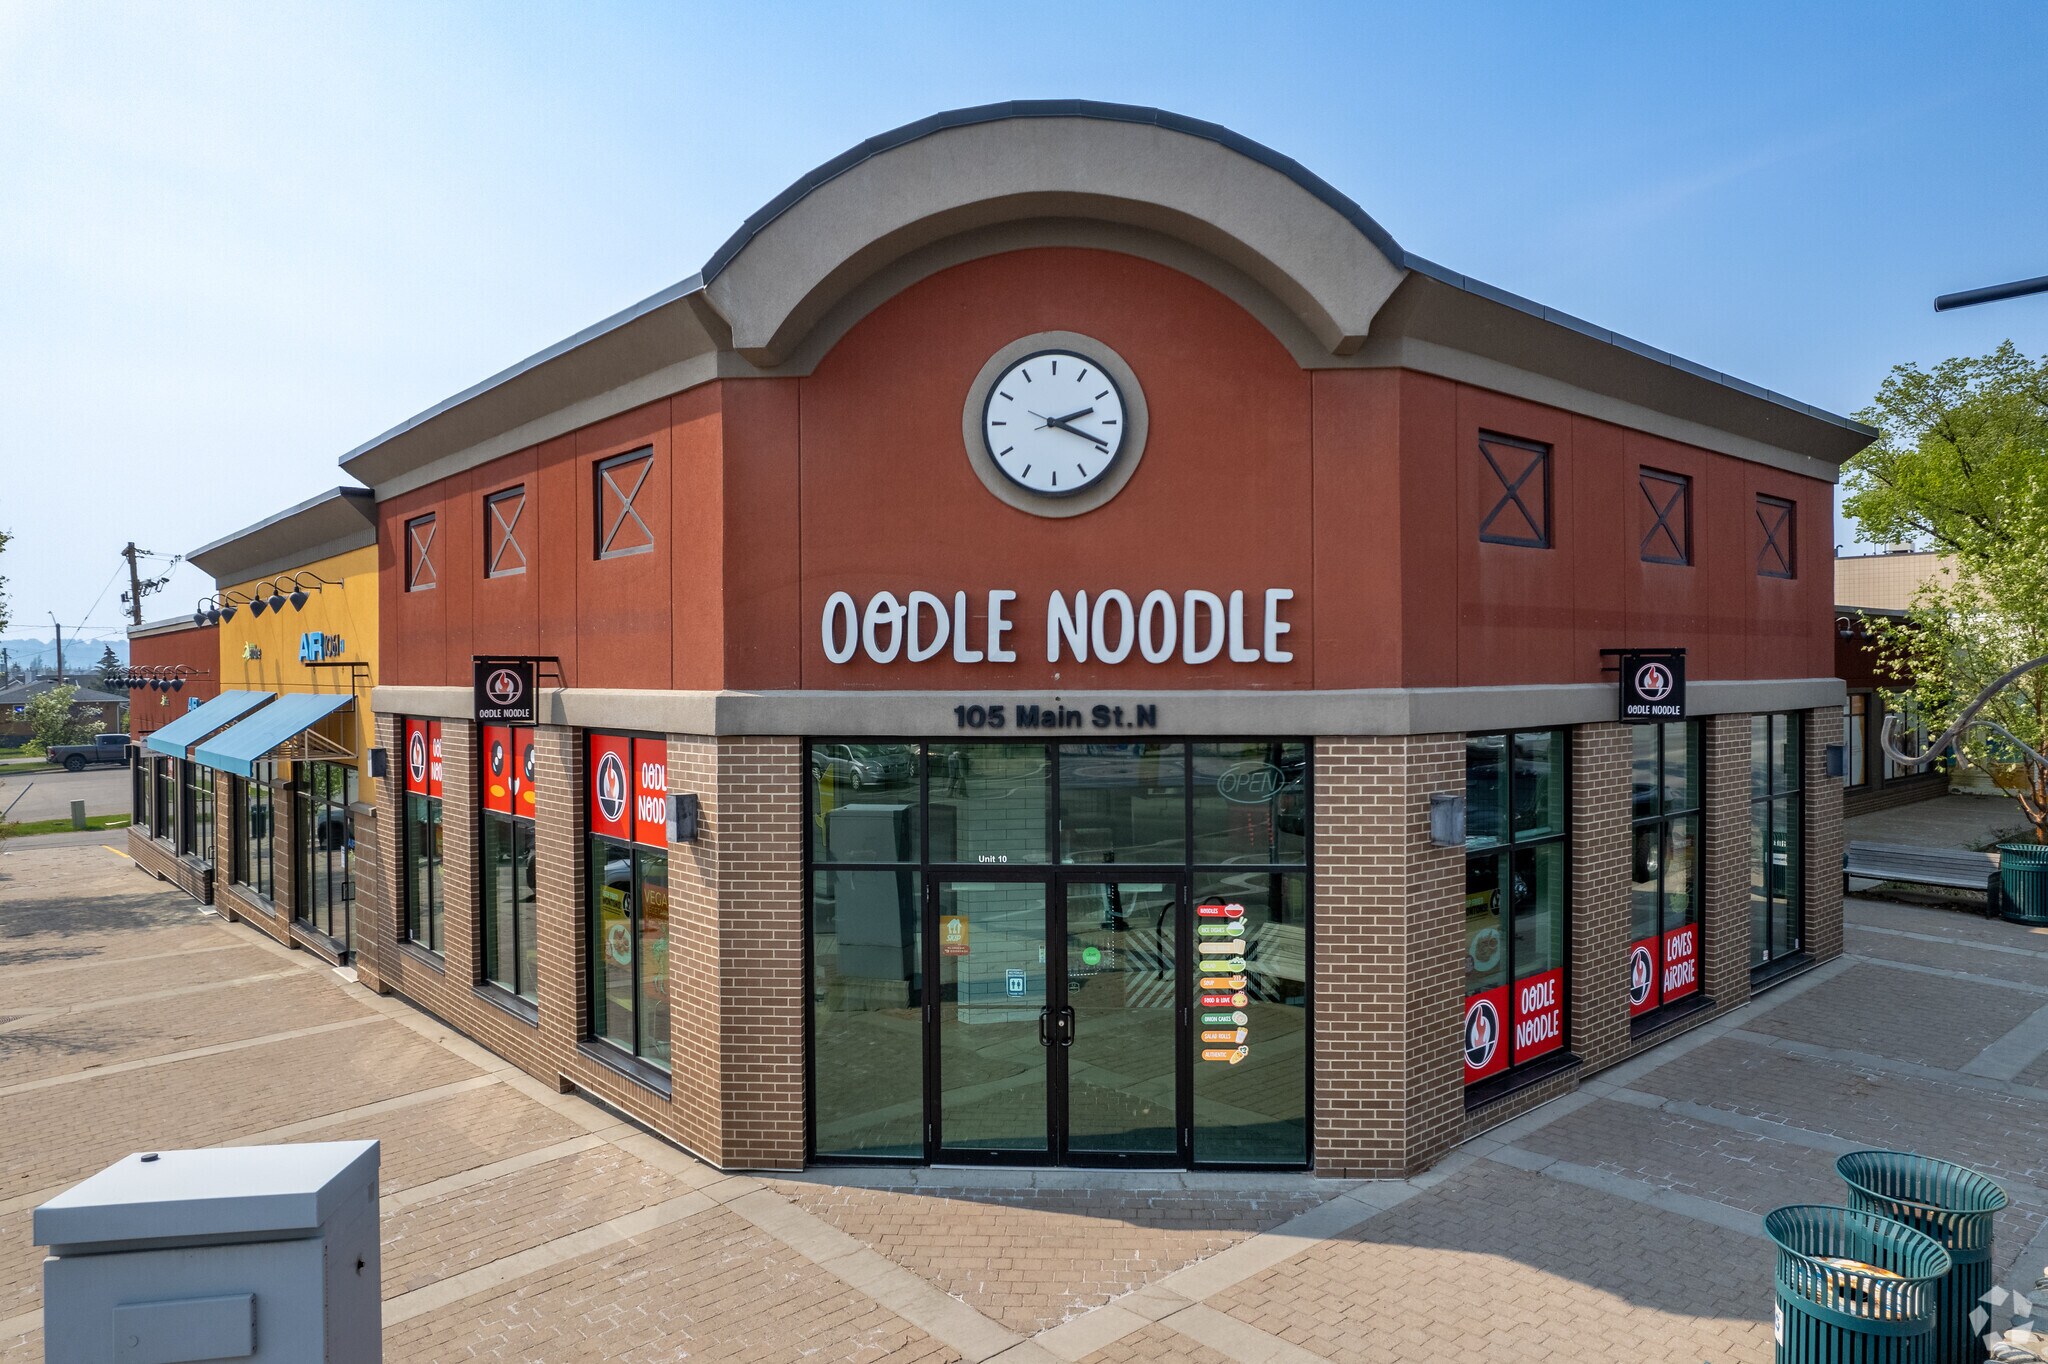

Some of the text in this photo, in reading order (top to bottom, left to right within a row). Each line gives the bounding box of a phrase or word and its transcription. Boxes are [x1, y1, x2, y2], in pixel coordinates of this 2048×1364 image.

[821, 588, 1294, 664] OODLE NOODLE
[504, 708, 530, 718] NOODLE
[954, 705, 1005, 728] 105
[1016, 705, 1082, 728] Main
[1652, 705, 1680, 715] NOODLE
[1221, 772, 1278, 793] OPEN
[978, 855, 1008, 863] Unit 10
[1667, 930, 1693, 962] LOVES
[1515, 1009, 1560, 1050] NOODLE
